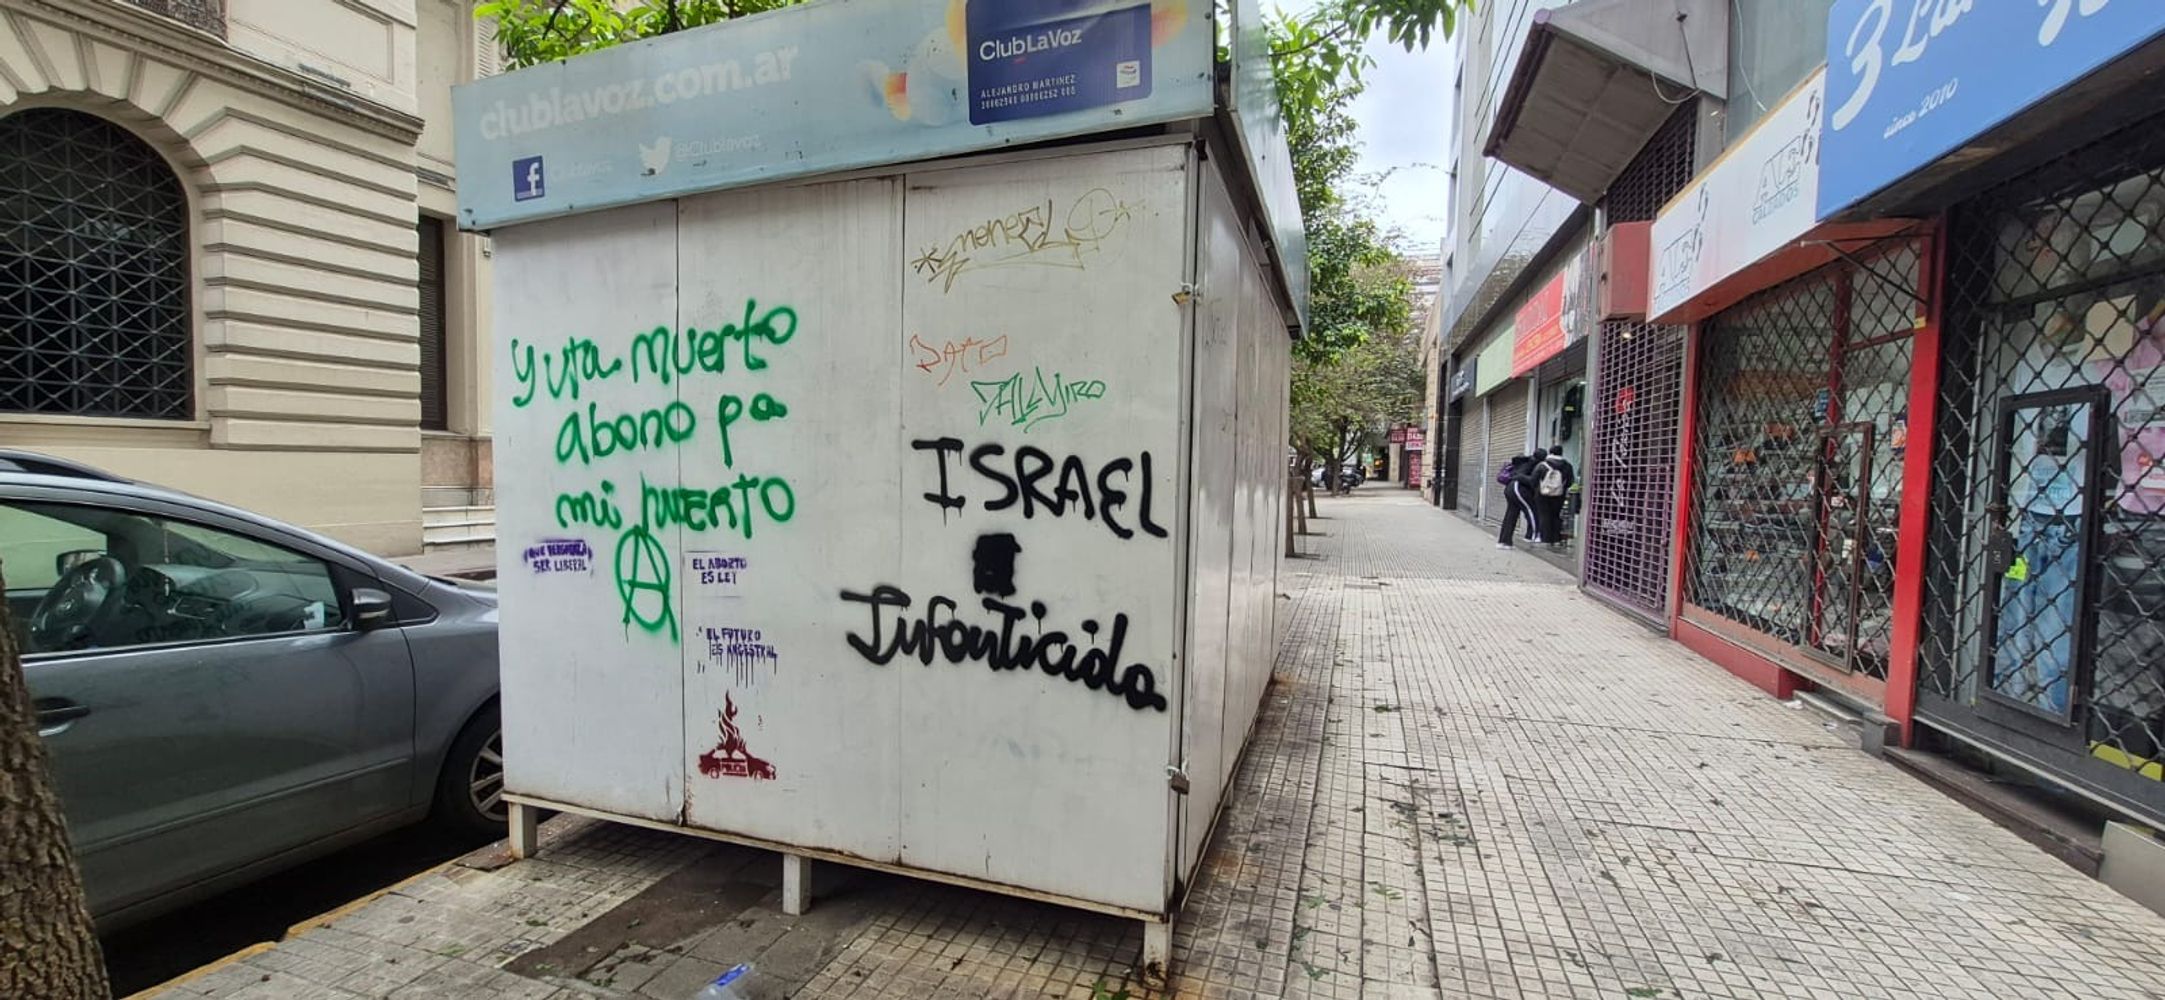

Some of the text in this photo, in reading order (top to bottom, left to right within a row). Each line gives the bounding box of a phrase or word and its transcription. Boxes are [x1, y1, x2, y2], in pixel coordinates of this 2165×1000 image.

[979, 28, 1082, 61] ClubLaVoz
[479, 45, 799, 141] clublavoz.com.ar
[981, 81, 1030, 98] ALEJANDRO
[1032, 74, 1076, 89] MARTINEZ
[1918, 78, 1959, 118] 2010
[556, 479, 622, 530] mi
[911, 437, 1168, 540] ISRAEL
[692, 558, 705, 570] EL
[701, 571, 714, 585] ES
[706, 627, 762, 642] EL FUTURO
